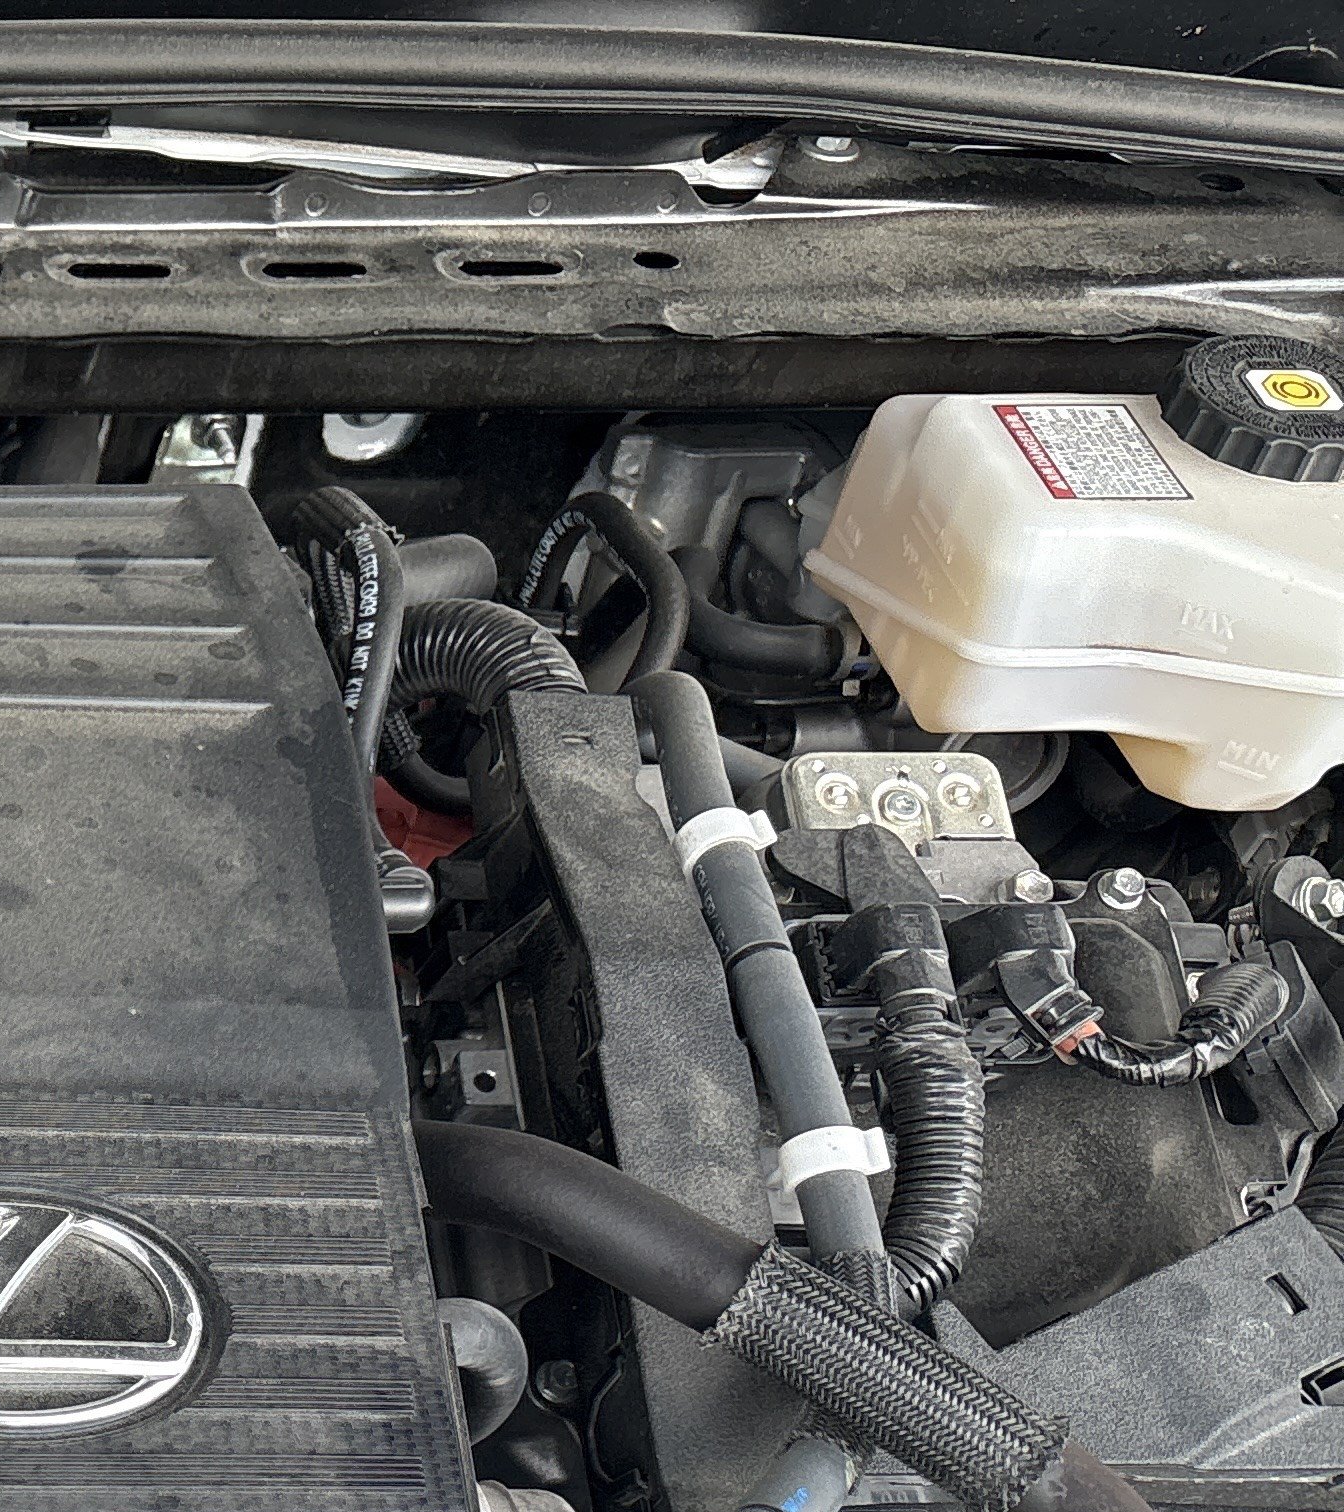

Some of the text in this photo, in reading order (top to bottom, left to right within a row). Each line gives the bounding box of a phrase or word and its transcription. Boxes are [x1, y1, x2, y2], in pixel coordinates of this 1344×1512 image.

[1013, 429, 1053, 466] DANGER
[1180, 600, 1235, 640] MAX
[1223, 739, 1282, 771] MIN
